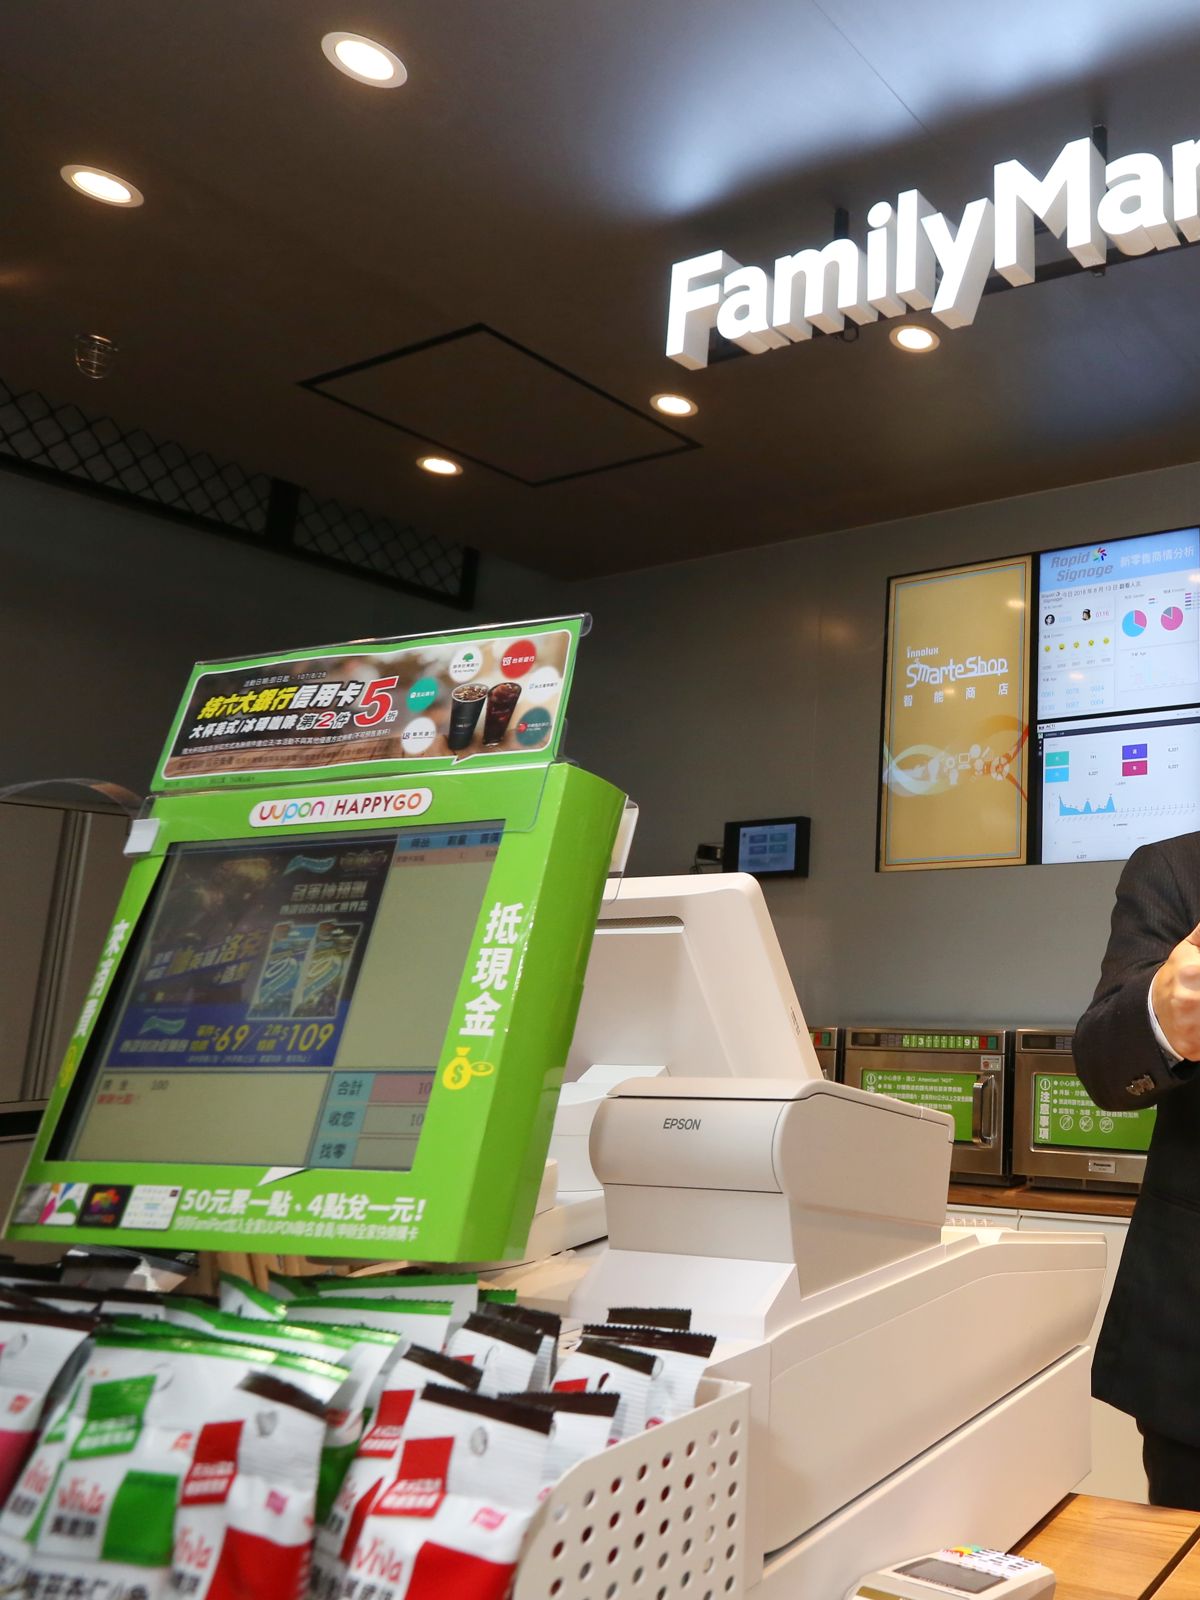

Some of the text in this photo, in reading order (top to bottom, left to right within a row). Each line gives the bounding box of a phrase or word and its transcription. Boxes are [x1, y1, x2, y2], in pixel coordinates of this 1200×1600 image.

[1051, 551, 1090, 570] Rapid
[1057, 564, 1114, 583] Signage
[354, 675, 400, 727] 5
[385, 710, 399, 723] 折
[459, 902, 523, 1037] 抵現金
[663, 1118, 701, 1131] EPSON
